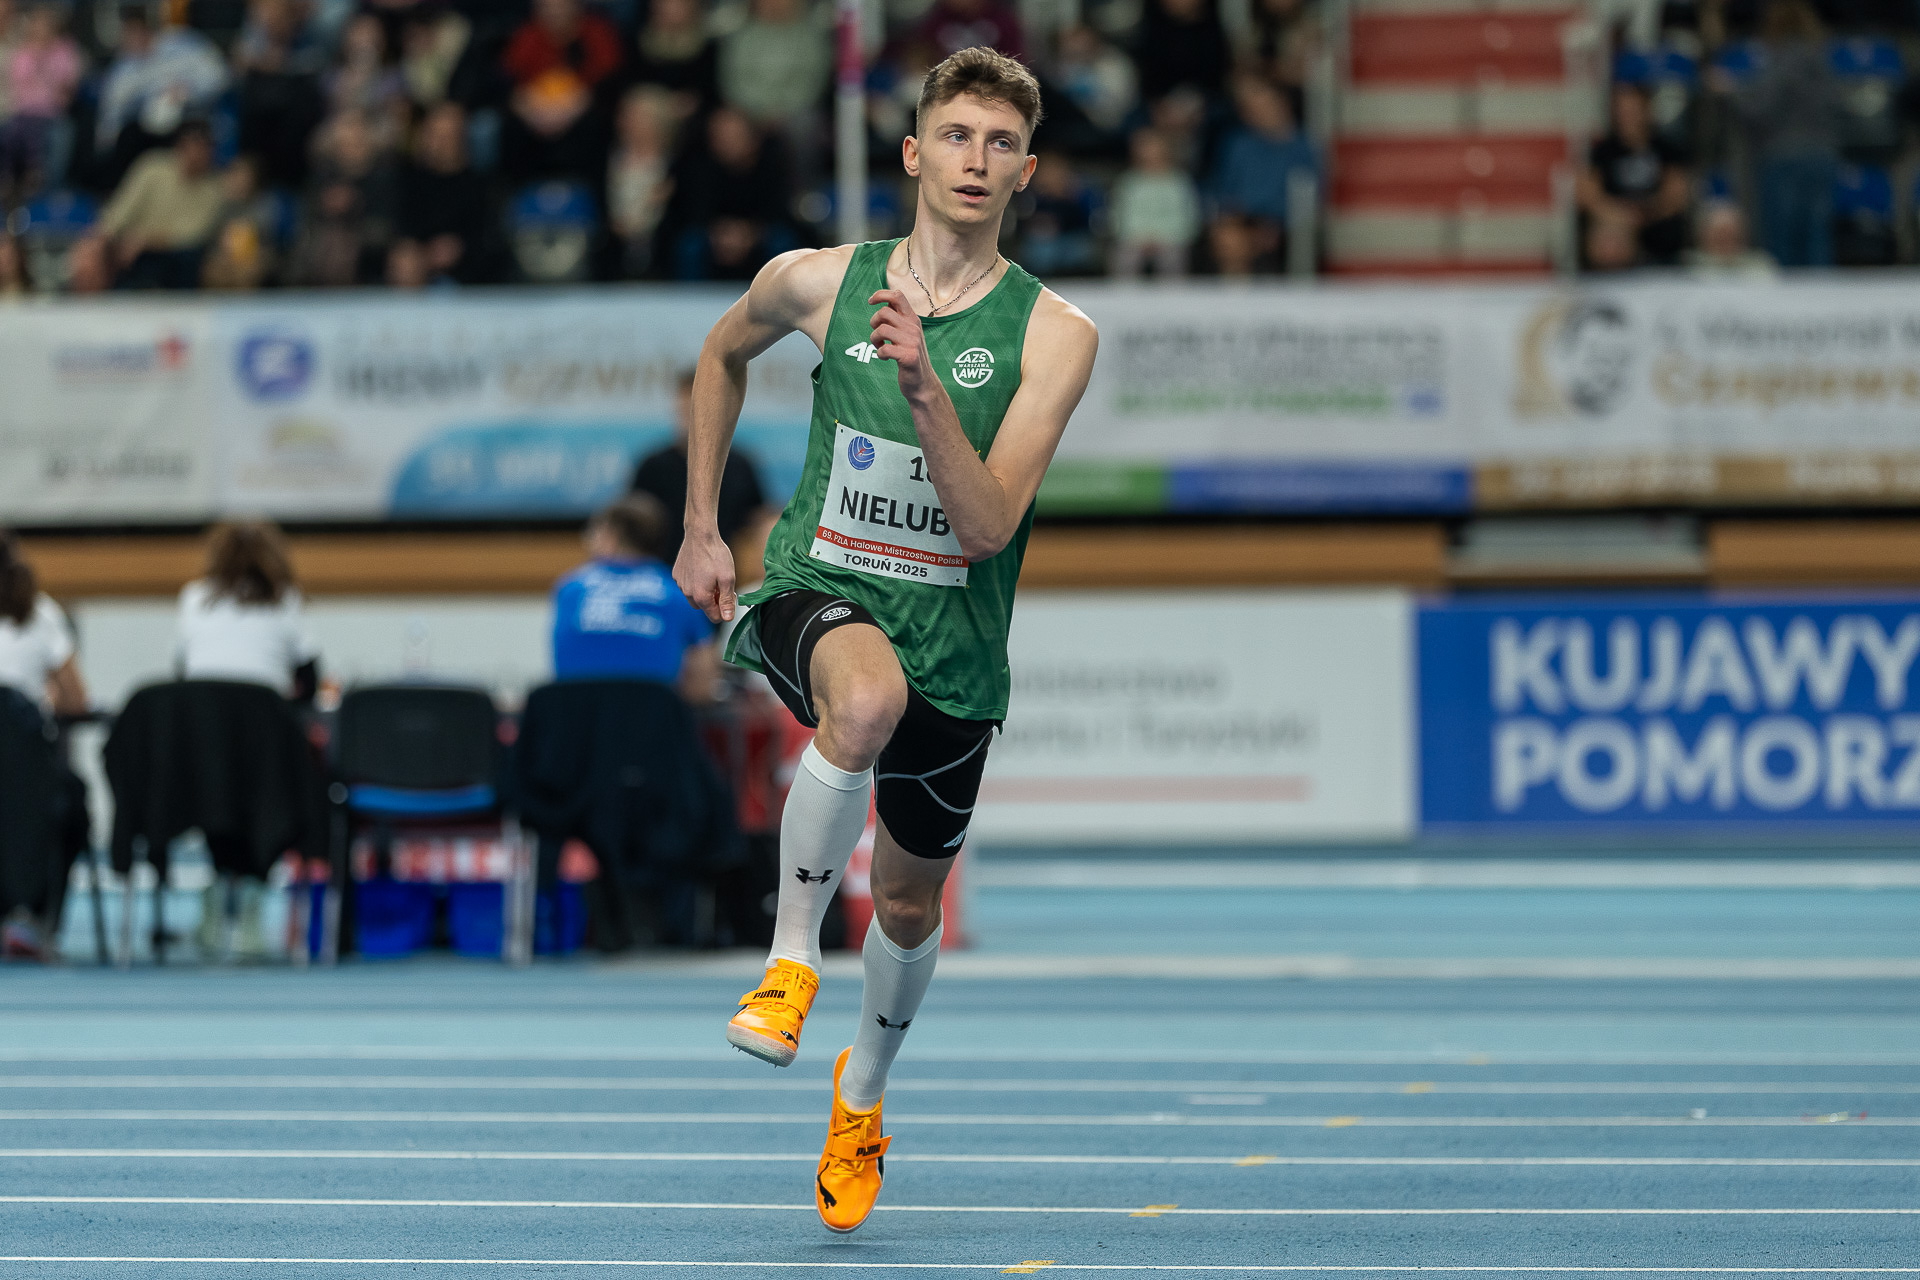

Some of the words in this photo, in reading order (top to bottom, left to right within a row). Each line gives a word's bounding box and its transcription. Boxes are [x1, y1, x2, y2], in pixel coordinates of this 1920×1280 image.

[963, 353, 987, 363] AZS
[958, 368, 986, 379] AWF
[909, 456, 933, 484] 1
[839, 485, 951, 537] NIELUB
[822, 529, 833, 540] 69.
[833, 535, 849, 546] PZLA
[850, 540, 883, 552] Halowe
[884, 546, 936, 563] Mistrzostwa
[937, 556, 964, 565] Polski
[843, 553, 891, 572] TORUŃ
[893, 562, 928, 578] 2025
[1490, 615, 1920, 712] KUJAWY
[752, 989, 787, 1000] PUMA
